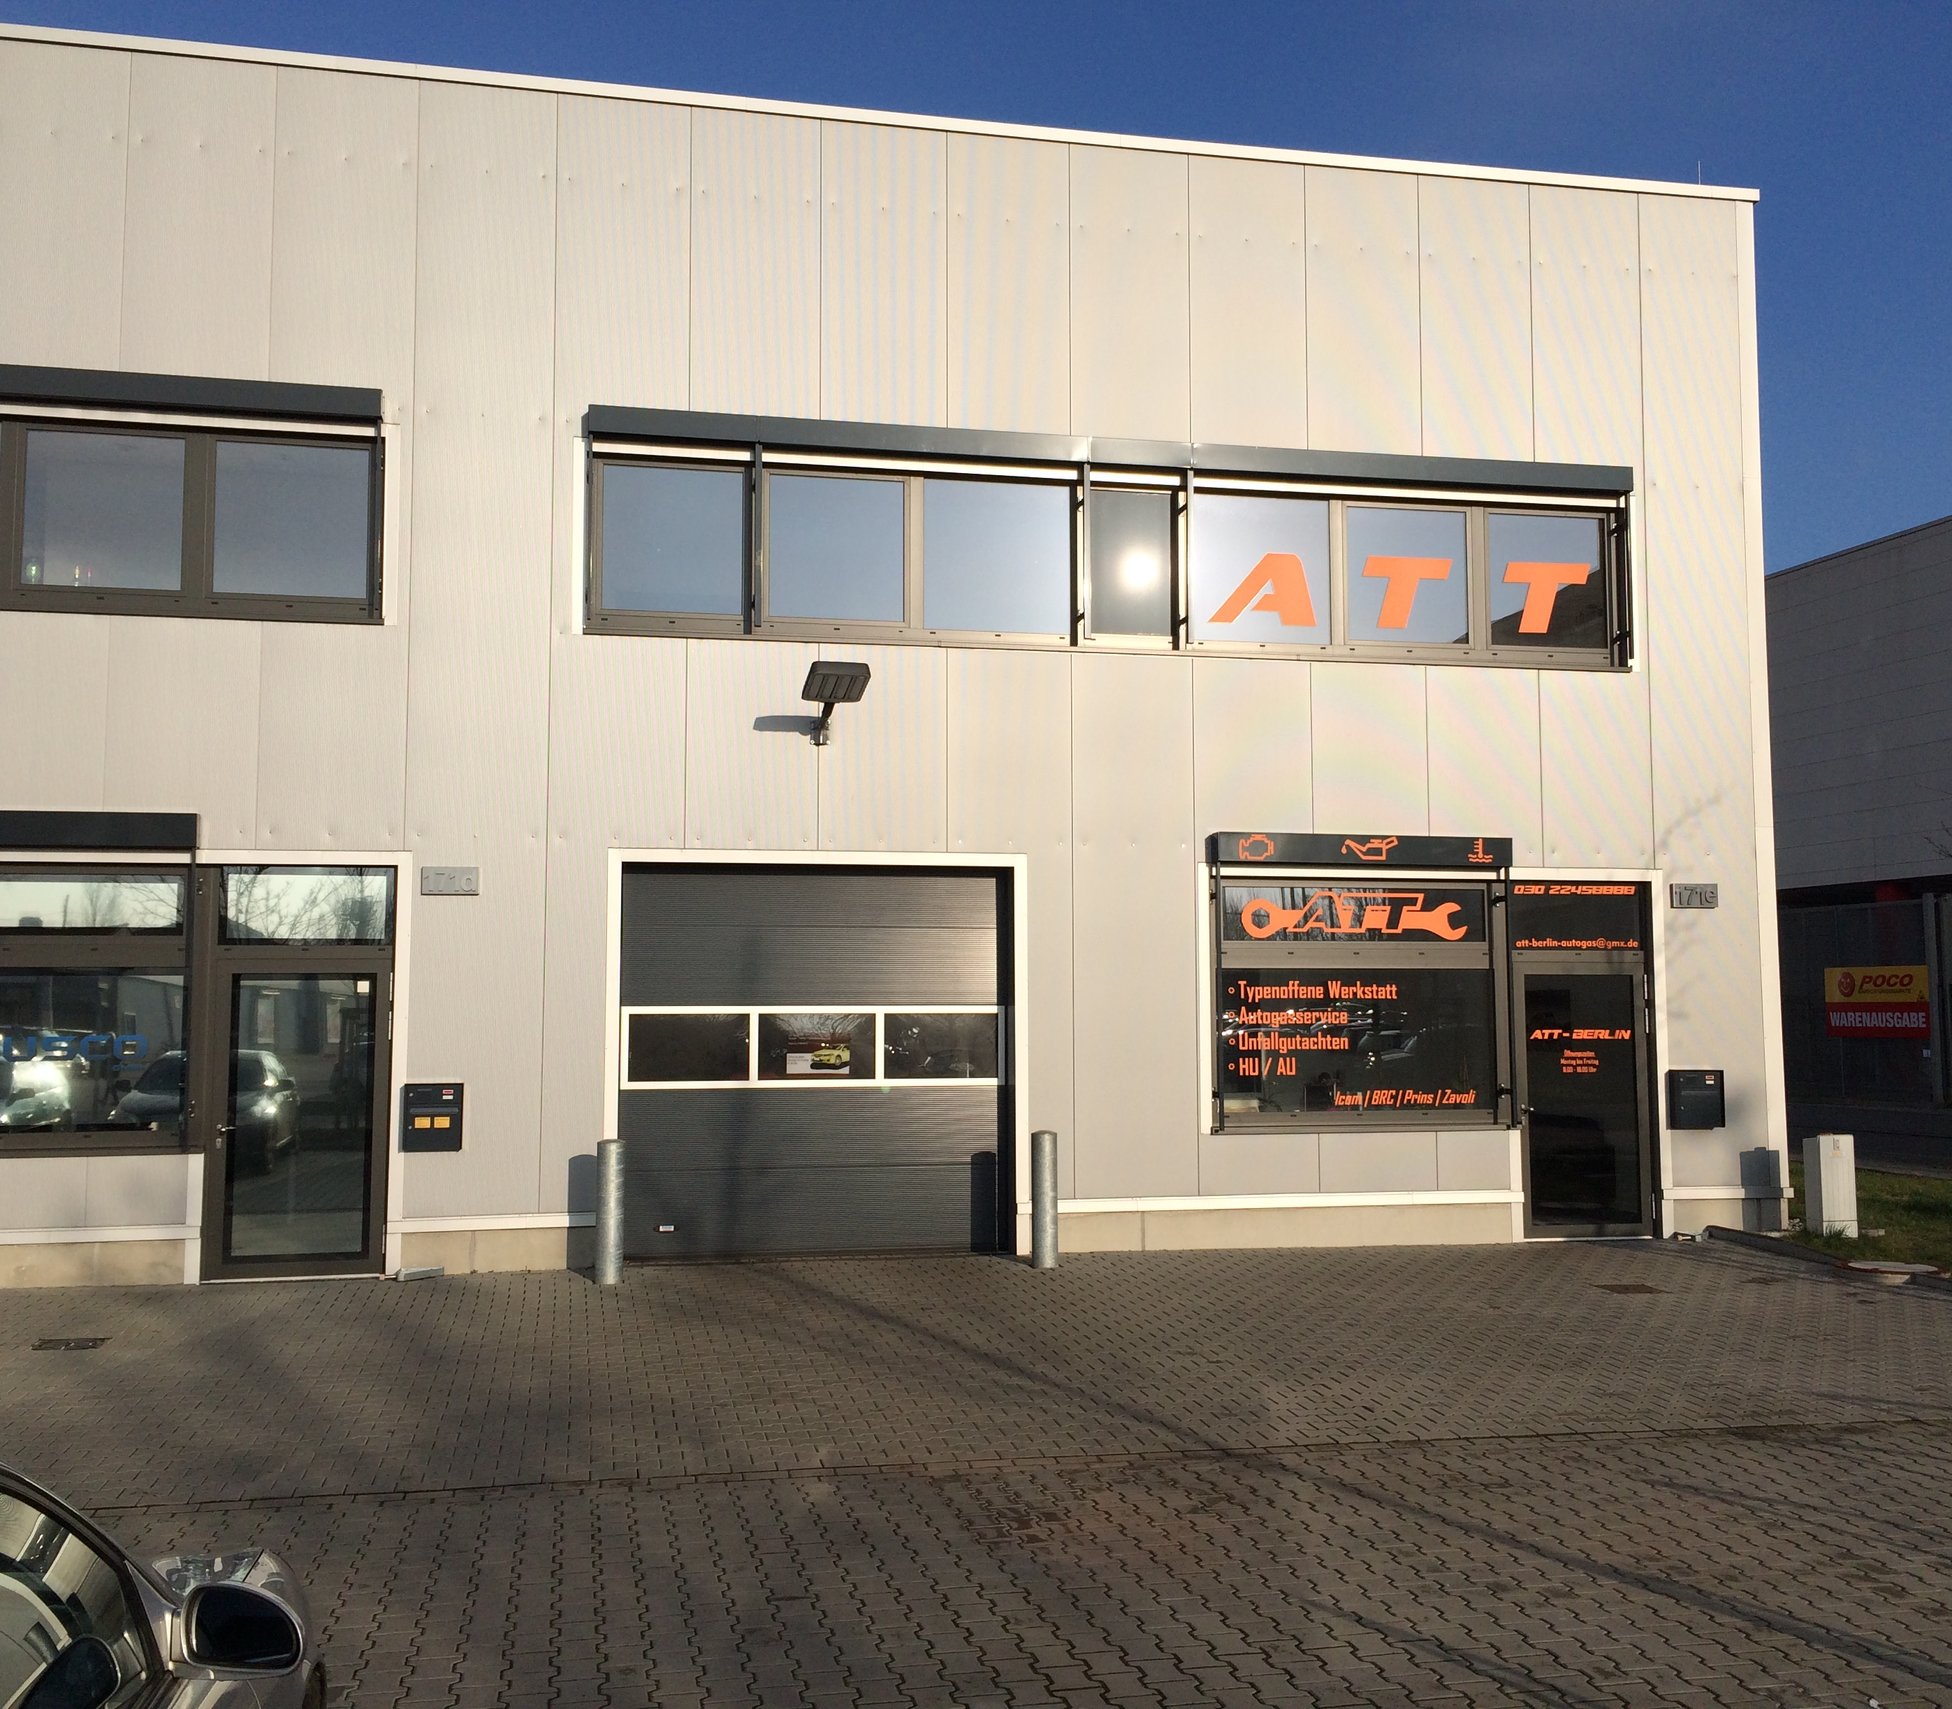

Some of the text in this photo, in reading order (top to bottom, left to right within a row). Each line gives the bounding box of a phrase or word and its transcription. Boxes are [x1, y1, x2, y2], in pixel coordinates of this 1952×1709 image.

[1207, 552, 1592, 634] ATT
[1513, 885, 1546, 895] 030
[1286, 891, 1425, 934] ATT
[1515, 937, 1639, 950] att-berlin-autogas@gmx.de
[1237, 980, 1398, 1003] Typenoffene Werkstatt
[1859, 973, 1914, 991] POCO
[1238, 1006, 1349, 1028] Autogasservice
[1829, 1011, 1927, 1029] WARENAUSGABE
[1238, 1031, 1349, 1054] Unfallgutachten
[1239, 1057, 1297, 1076] HU / AU
[1335, 1091, 1363, 1106] Icom
[1371, 1089, 1396, 1105] BRC
[1403, 1089, 1434, 1105] Prins
[1442, 1088, 1477, 1104] Zavoli
